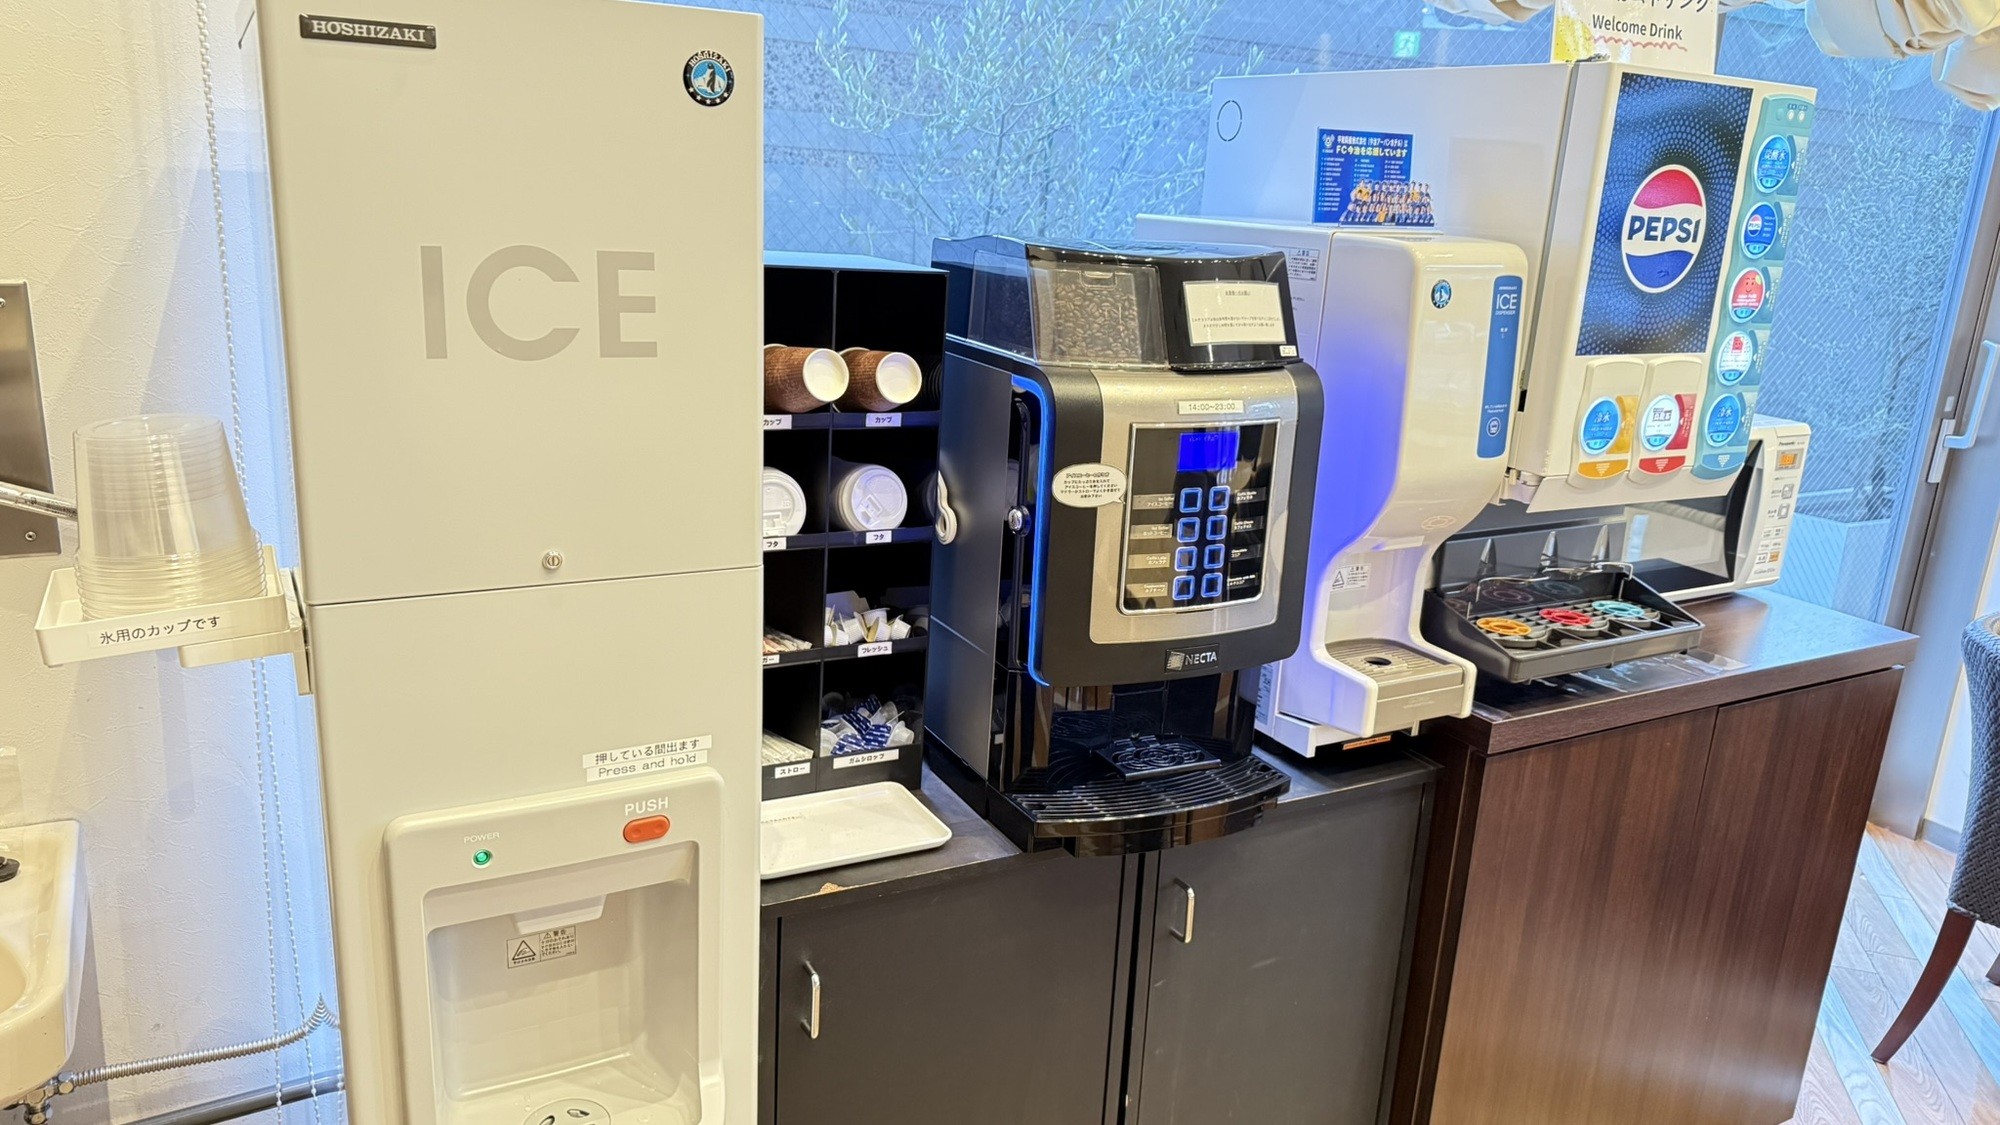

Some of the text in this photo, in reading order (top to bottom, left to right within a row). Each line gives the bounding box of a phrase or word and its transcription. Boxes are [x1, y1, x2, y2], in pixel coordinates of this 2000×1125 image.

[311, 20, 426, 43] HOSHIZAKI
[1593, 14, 1683, 41] Welcome Drink
[1627, 215, 1702, 243] PEPSI
[420, 244, 658, 362] ICE
[1496, 293, 1518, 310] ICE
[875, 416, 893, 424] カップ
[873, 533, 885, 541] フタ
[100, 616, 220, 645] 氷用のカップです
[861, 645, 889, 654] フレッシュ
[1185, 652, 1218, 666] NECTA
[595, 739, 700, 765] 押している間出ます
[849, 753, 885, 764] ガムシロップ
[598, 754, 697, 778] Press and hold
[780, 766, 806, 776] ストロー
[624, 796, 669, 816] PUSH
[463, 831, 500, 844] POWER
